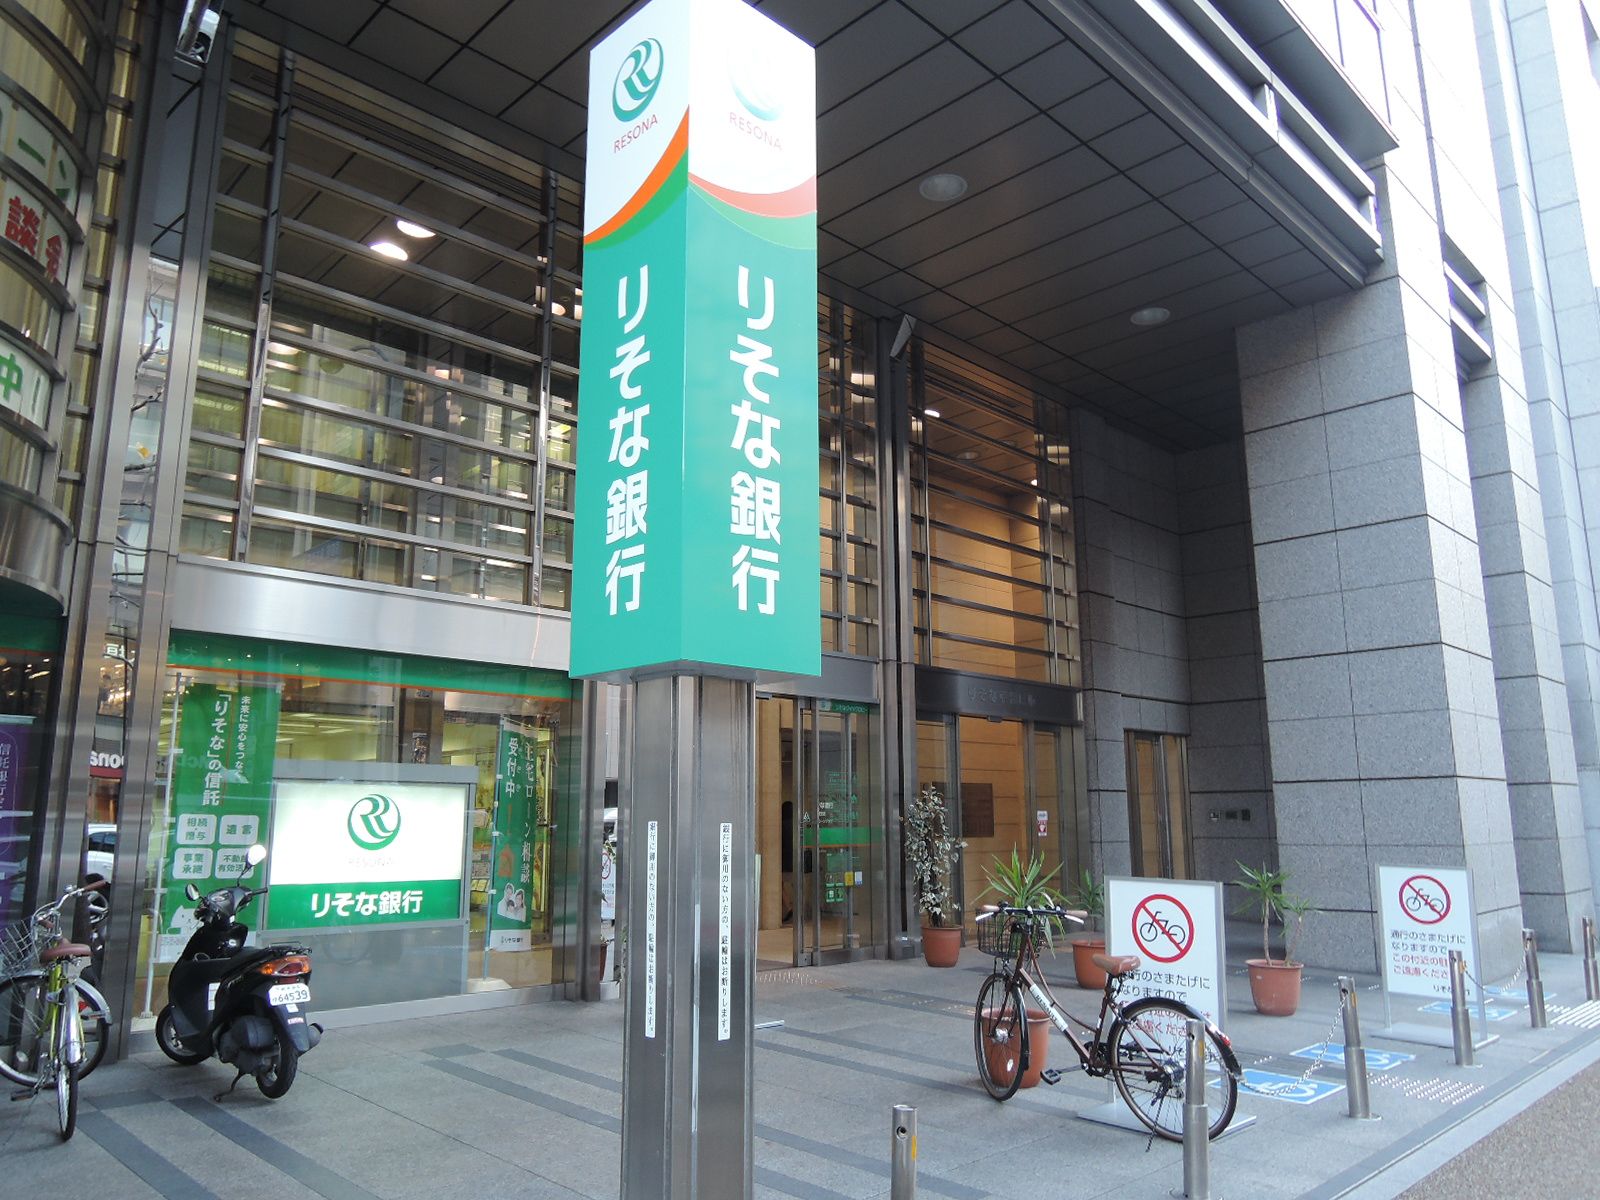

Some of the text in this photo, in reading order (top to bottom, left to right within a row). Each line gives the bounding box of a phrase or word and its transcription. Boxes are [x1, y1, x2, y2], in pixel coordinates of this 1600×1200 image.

[613, 114, 659, 153] RESONA
[729, 112, 784, 151] RESONA
[605, 264, 651, 616] りそな銀行
[729, 265, 781, 615] りそな銀行
[202, 693, 232, 806] 「りそな」の信託
[311, 889, 424, 918] りそな銀行
[278, 990, 308, 1002] 64539
